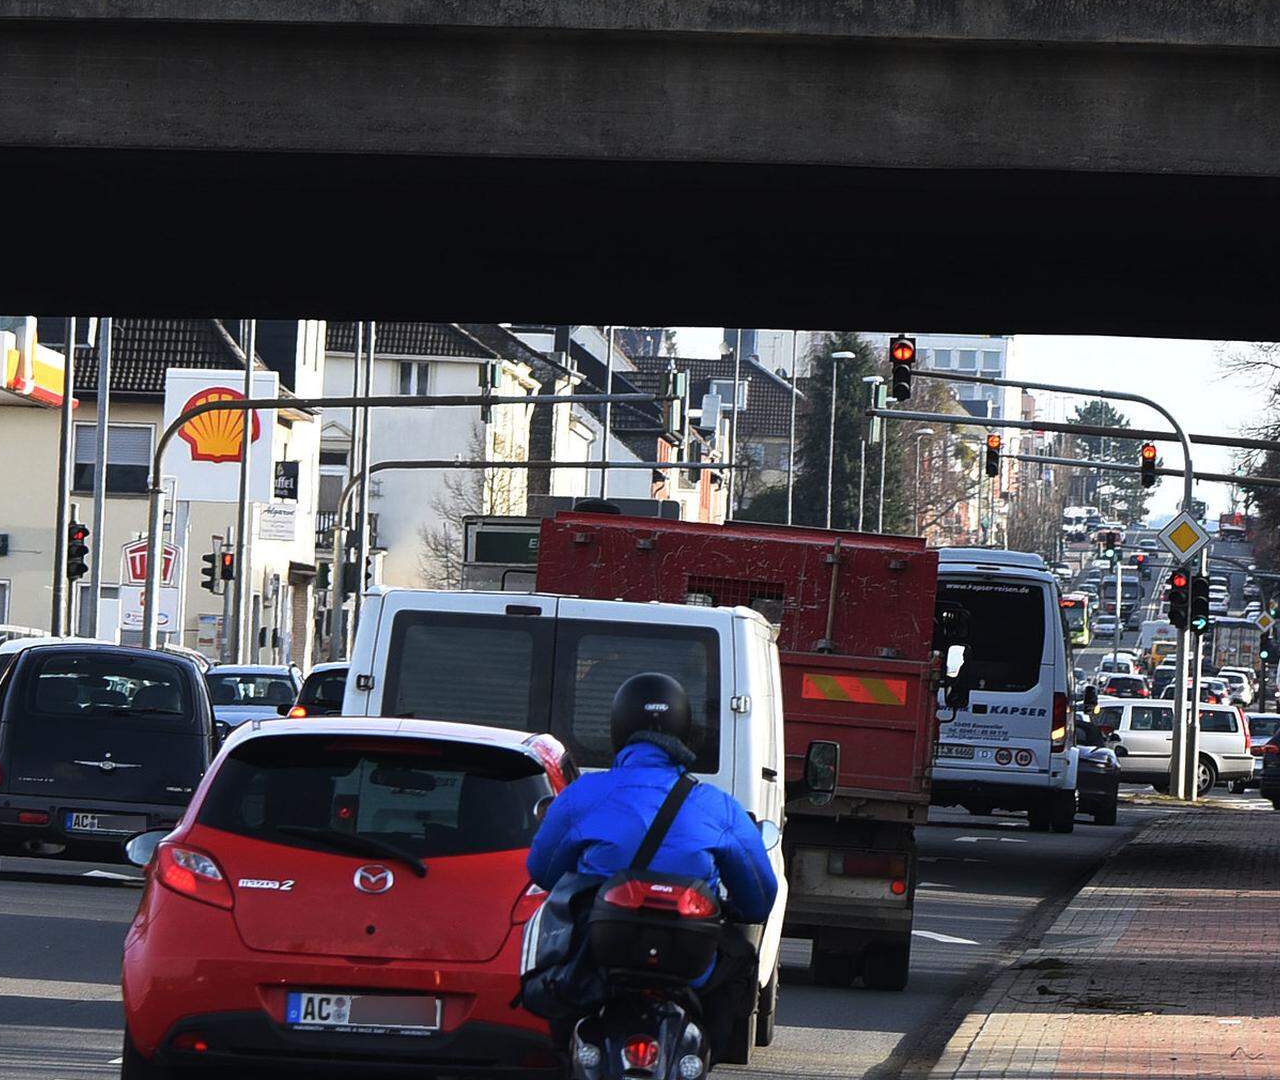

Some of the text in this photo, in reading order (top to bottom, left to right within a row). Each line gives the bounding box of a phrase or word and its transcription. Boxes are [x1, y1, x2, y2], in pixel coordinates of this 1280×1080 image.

[990, 705, 1047, 717] KAPSER
[74, 814, 90, 829] AC
[303, 997, 331, 1021] AC
